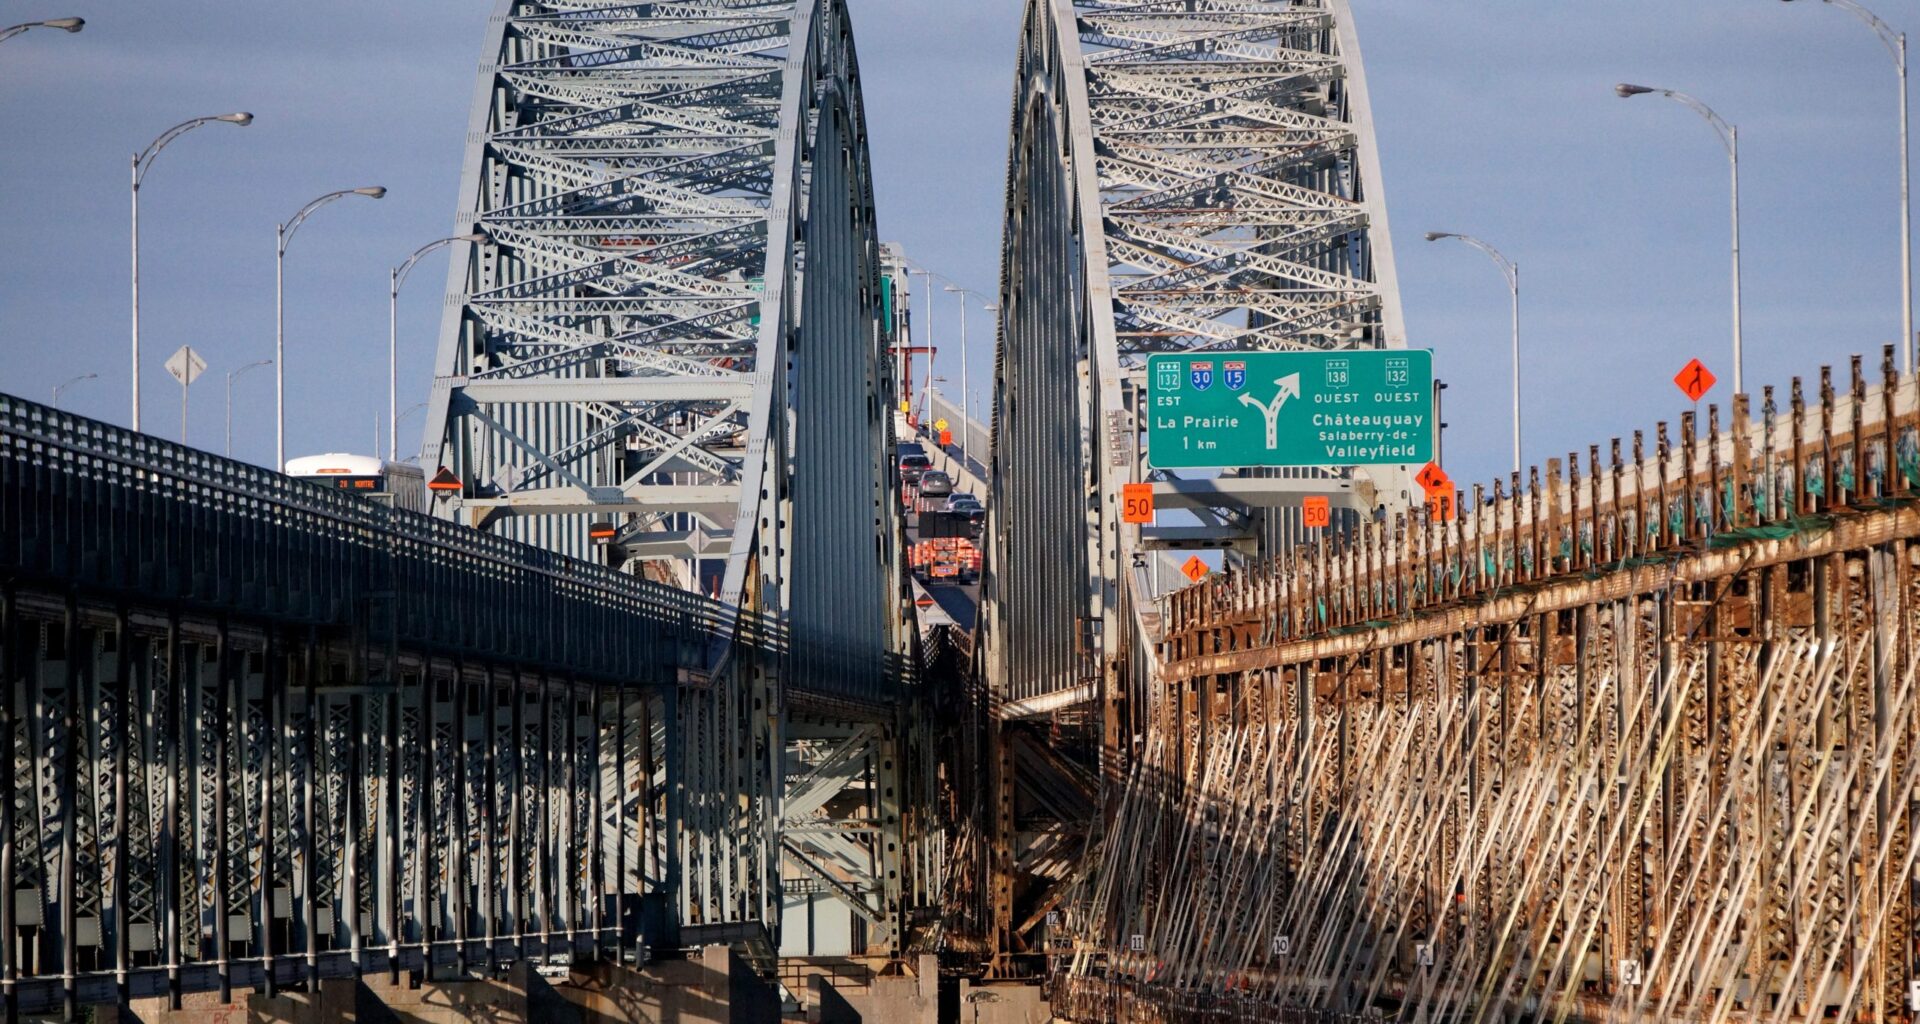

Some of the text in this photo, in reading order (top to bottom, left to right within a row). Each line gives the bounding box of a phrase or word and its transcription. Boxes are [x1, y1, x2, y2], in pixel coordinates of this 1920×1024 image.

[1160, 371, 1242, 386] 132 30 15
[1328, 370, 1407, 383] 138 132
[1157, 396, 1181, 406] EST
[1314, 392, 1419, 404] OUEST OUEST
[1157, 415, 1239, 429] La Prairie
[1312, 413, 1423, 429] Châteauguay
[1183, 436, 1217, 450] 1 km
[1325, 444, 1416, 460] Valleyfield
[1127, 498, 1149, 516] 50
[1307, 506, 1326, 521] 50
[1132, 936, 1142, 949] 11
[1275, 939, 1288, 952] 10
